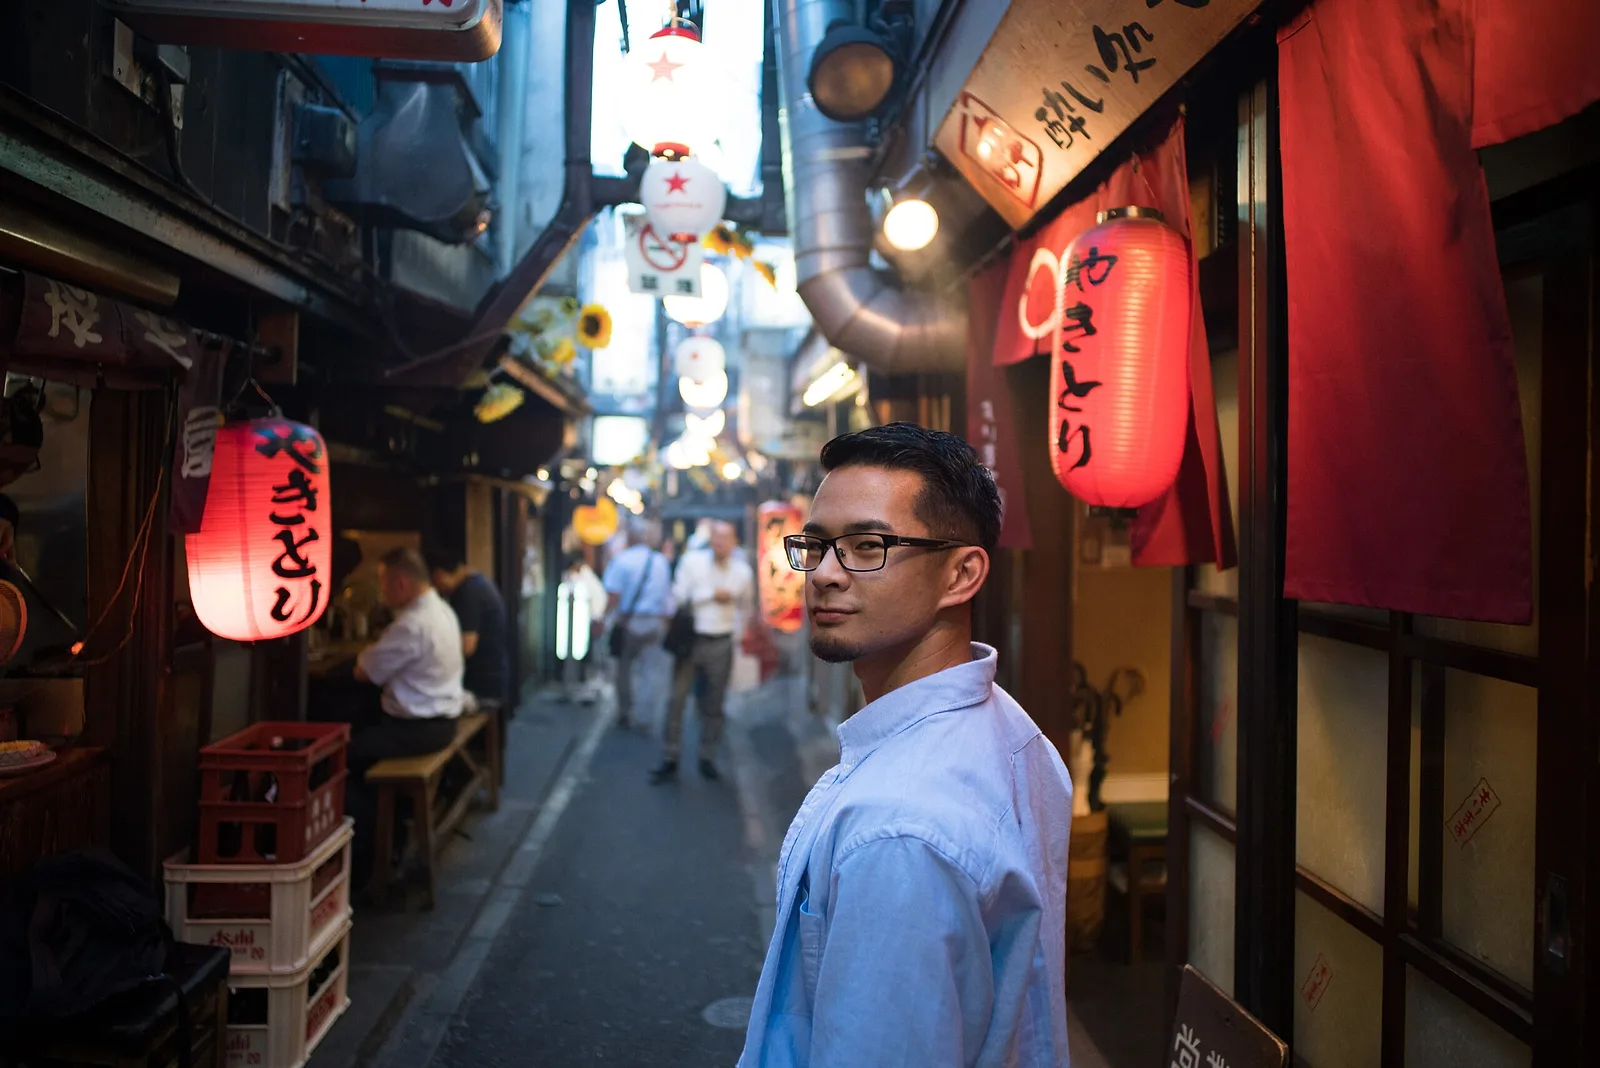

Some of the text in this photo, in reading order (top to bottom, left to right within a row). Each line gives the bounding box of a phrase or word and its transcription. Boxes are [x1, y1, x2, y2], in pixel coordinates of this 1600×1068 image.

[1058, 246, 1119, 473] やきとり
[252, 424, 324, 622] やきとり
